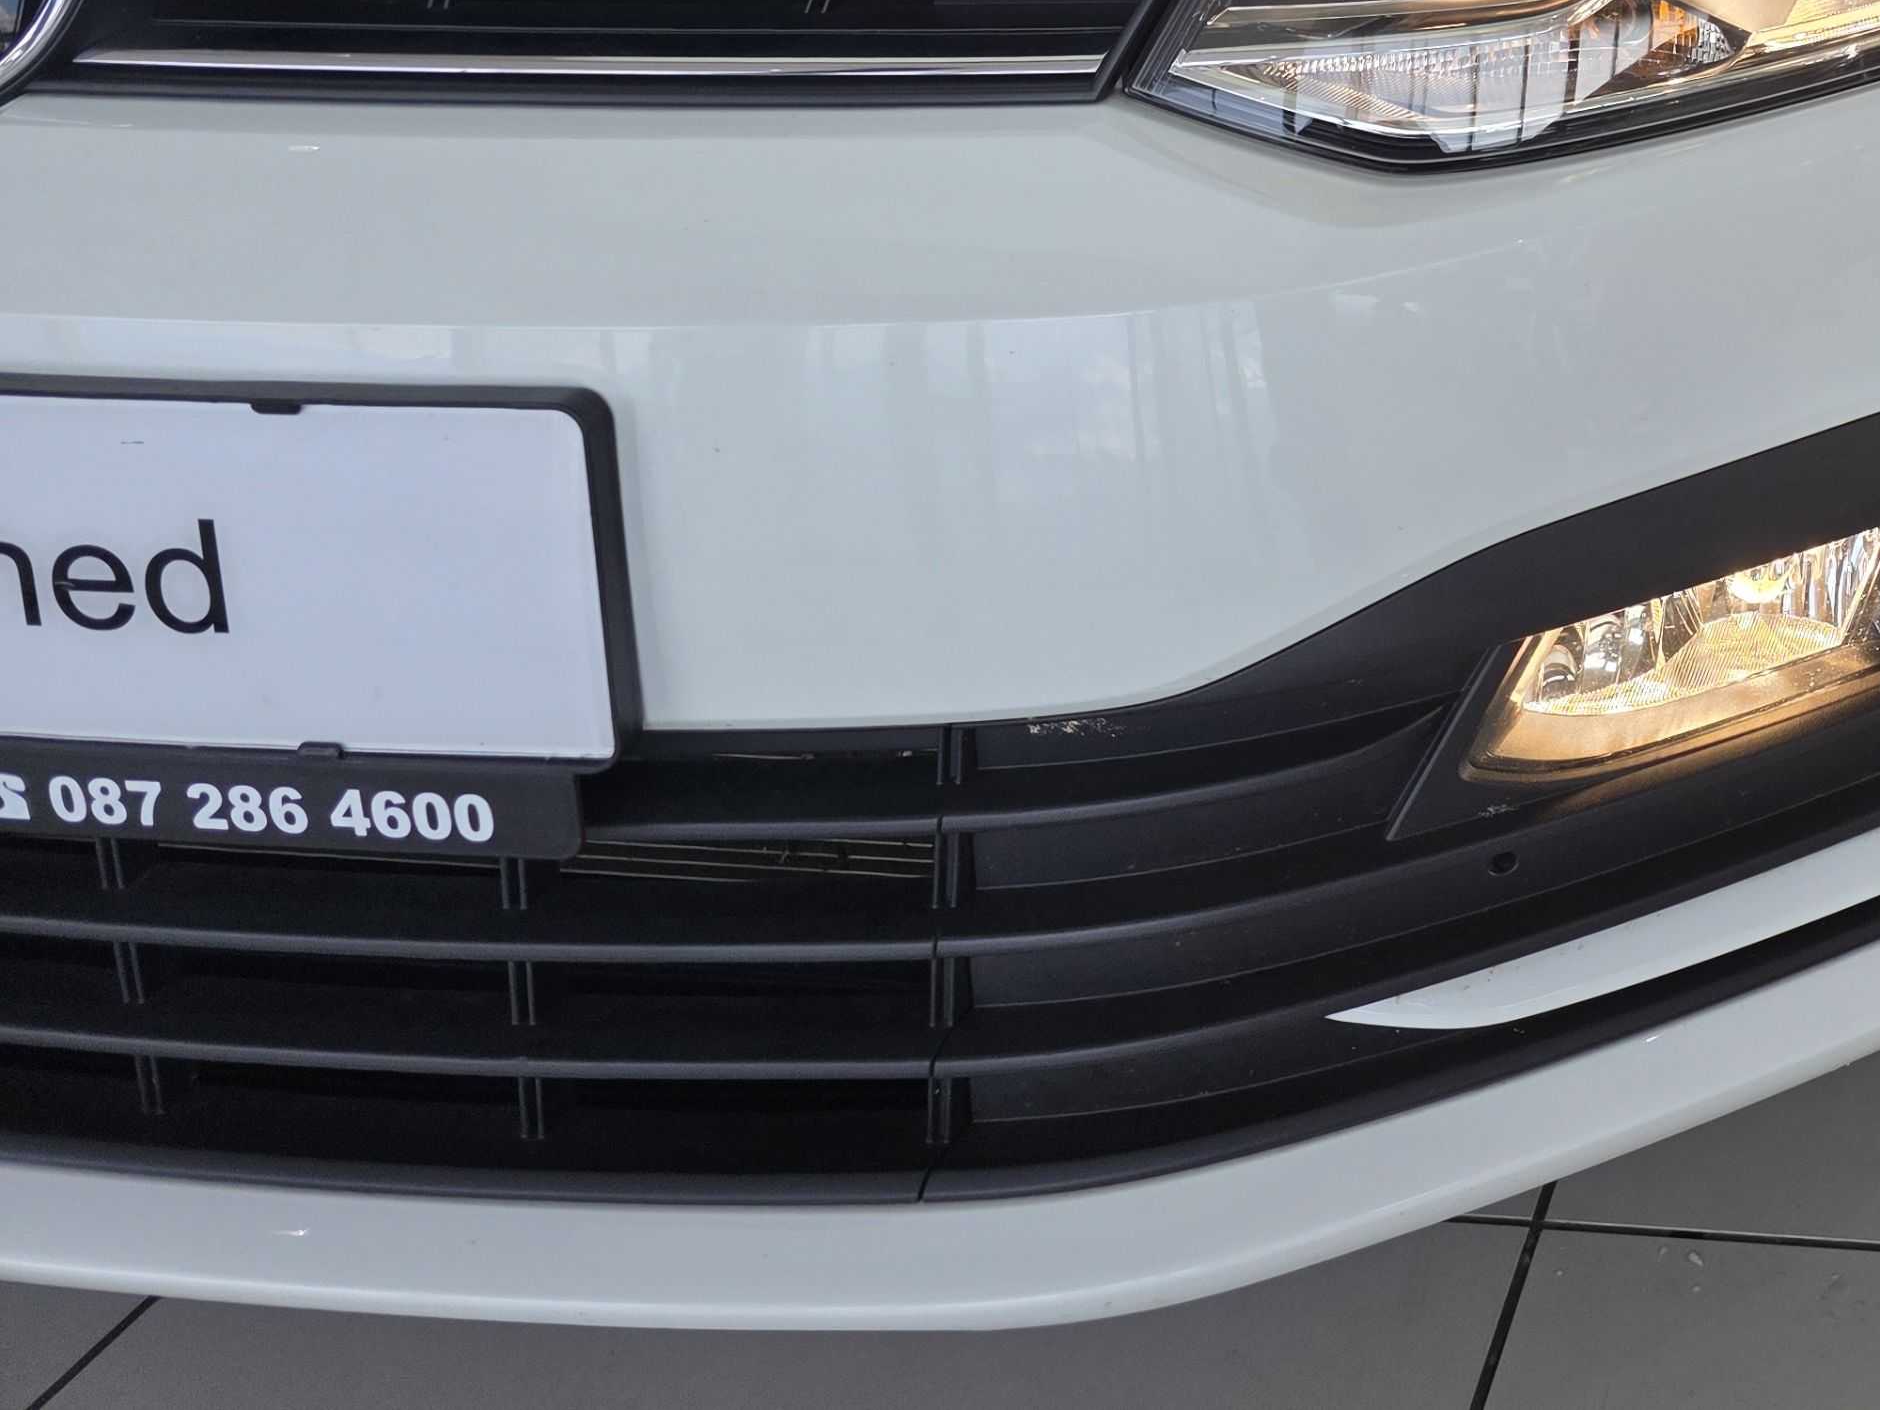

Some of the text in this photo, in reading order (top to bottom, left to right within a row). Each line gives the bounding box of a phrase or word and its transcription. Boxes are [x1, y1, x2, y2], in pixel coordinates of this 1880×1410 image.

[48, 776, 494, 842] 087 286 4600
